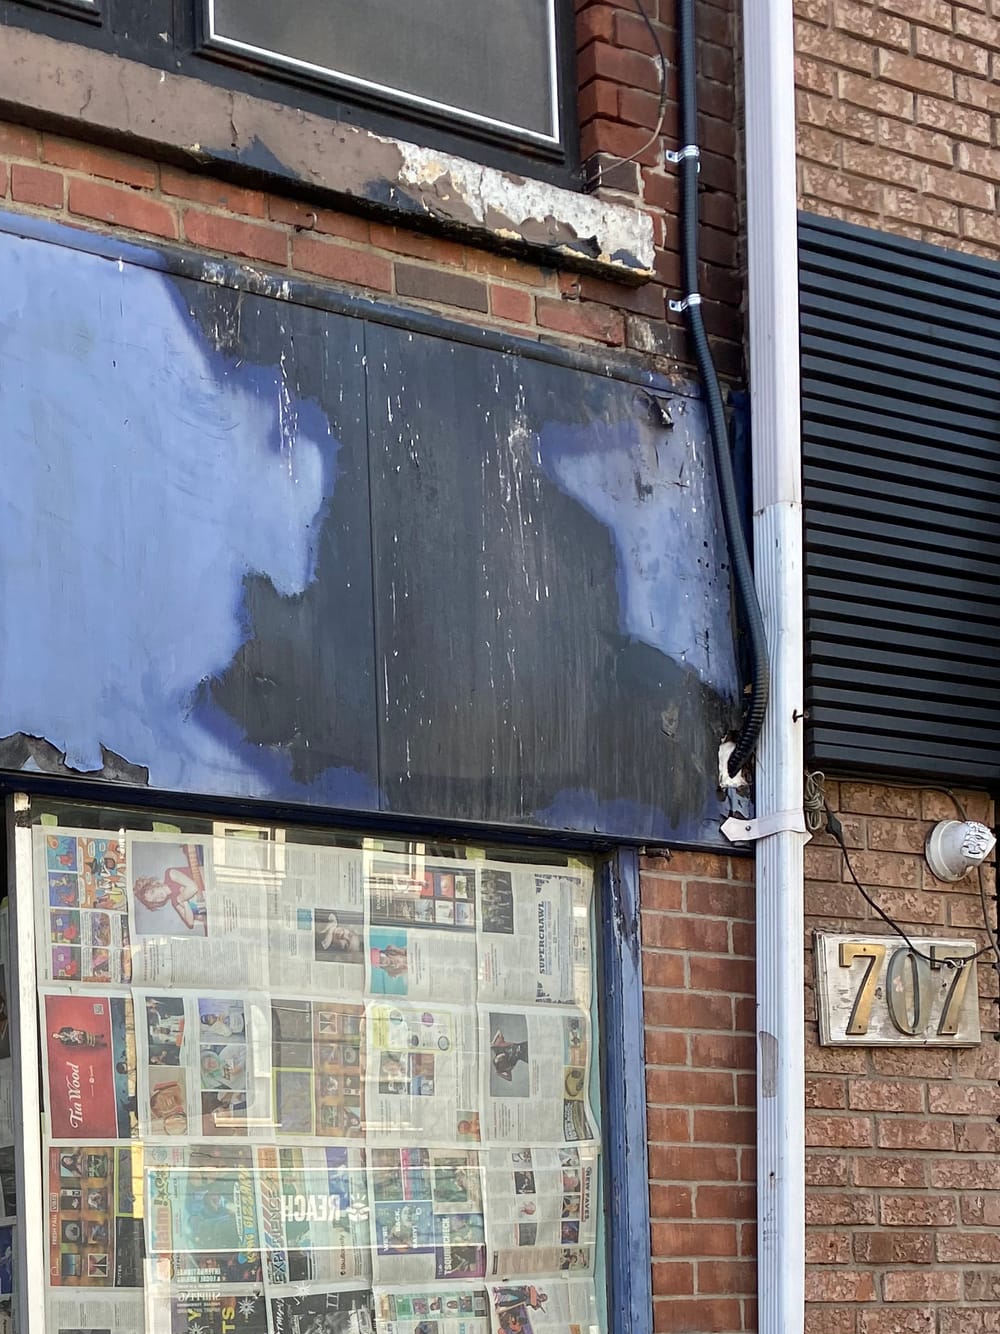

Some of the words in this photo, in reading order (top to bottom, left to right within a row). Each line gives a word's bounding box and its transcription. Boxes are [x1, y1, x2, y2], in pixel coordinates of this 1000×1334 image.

[537, 900, 546, 975] SUPERCRAWL
[839, 943, 976, 1036] 707
[65, 1061, 82, 1102] Wood
[68, 1102, 83, 1129] Tia
